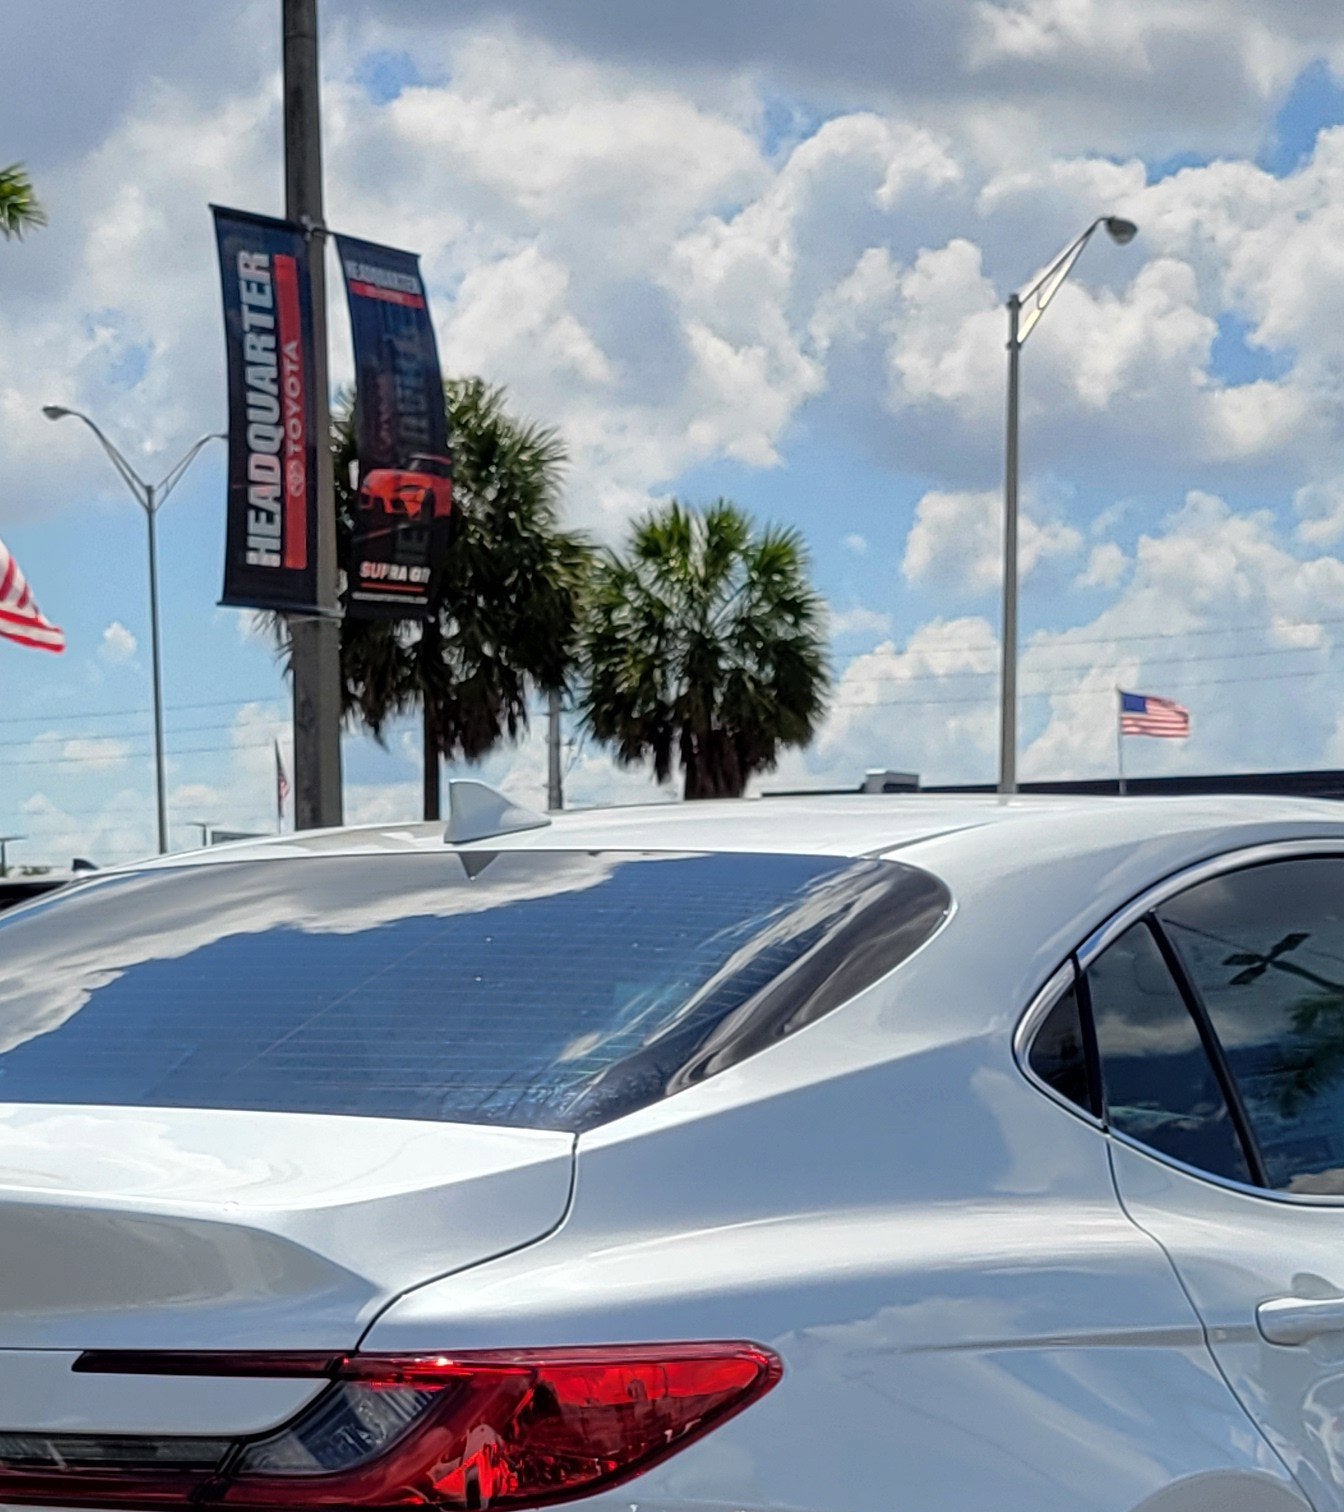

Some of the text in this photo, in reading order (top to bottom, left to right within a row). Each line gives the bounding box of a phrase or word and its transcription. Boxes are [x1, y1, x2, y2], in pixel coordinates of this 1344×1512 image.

[238, 251, 283, 567] HEADQUARTER
[283, 341, 304, 457] TOYOTA
[359, 561, 408, 582] SUPRA
